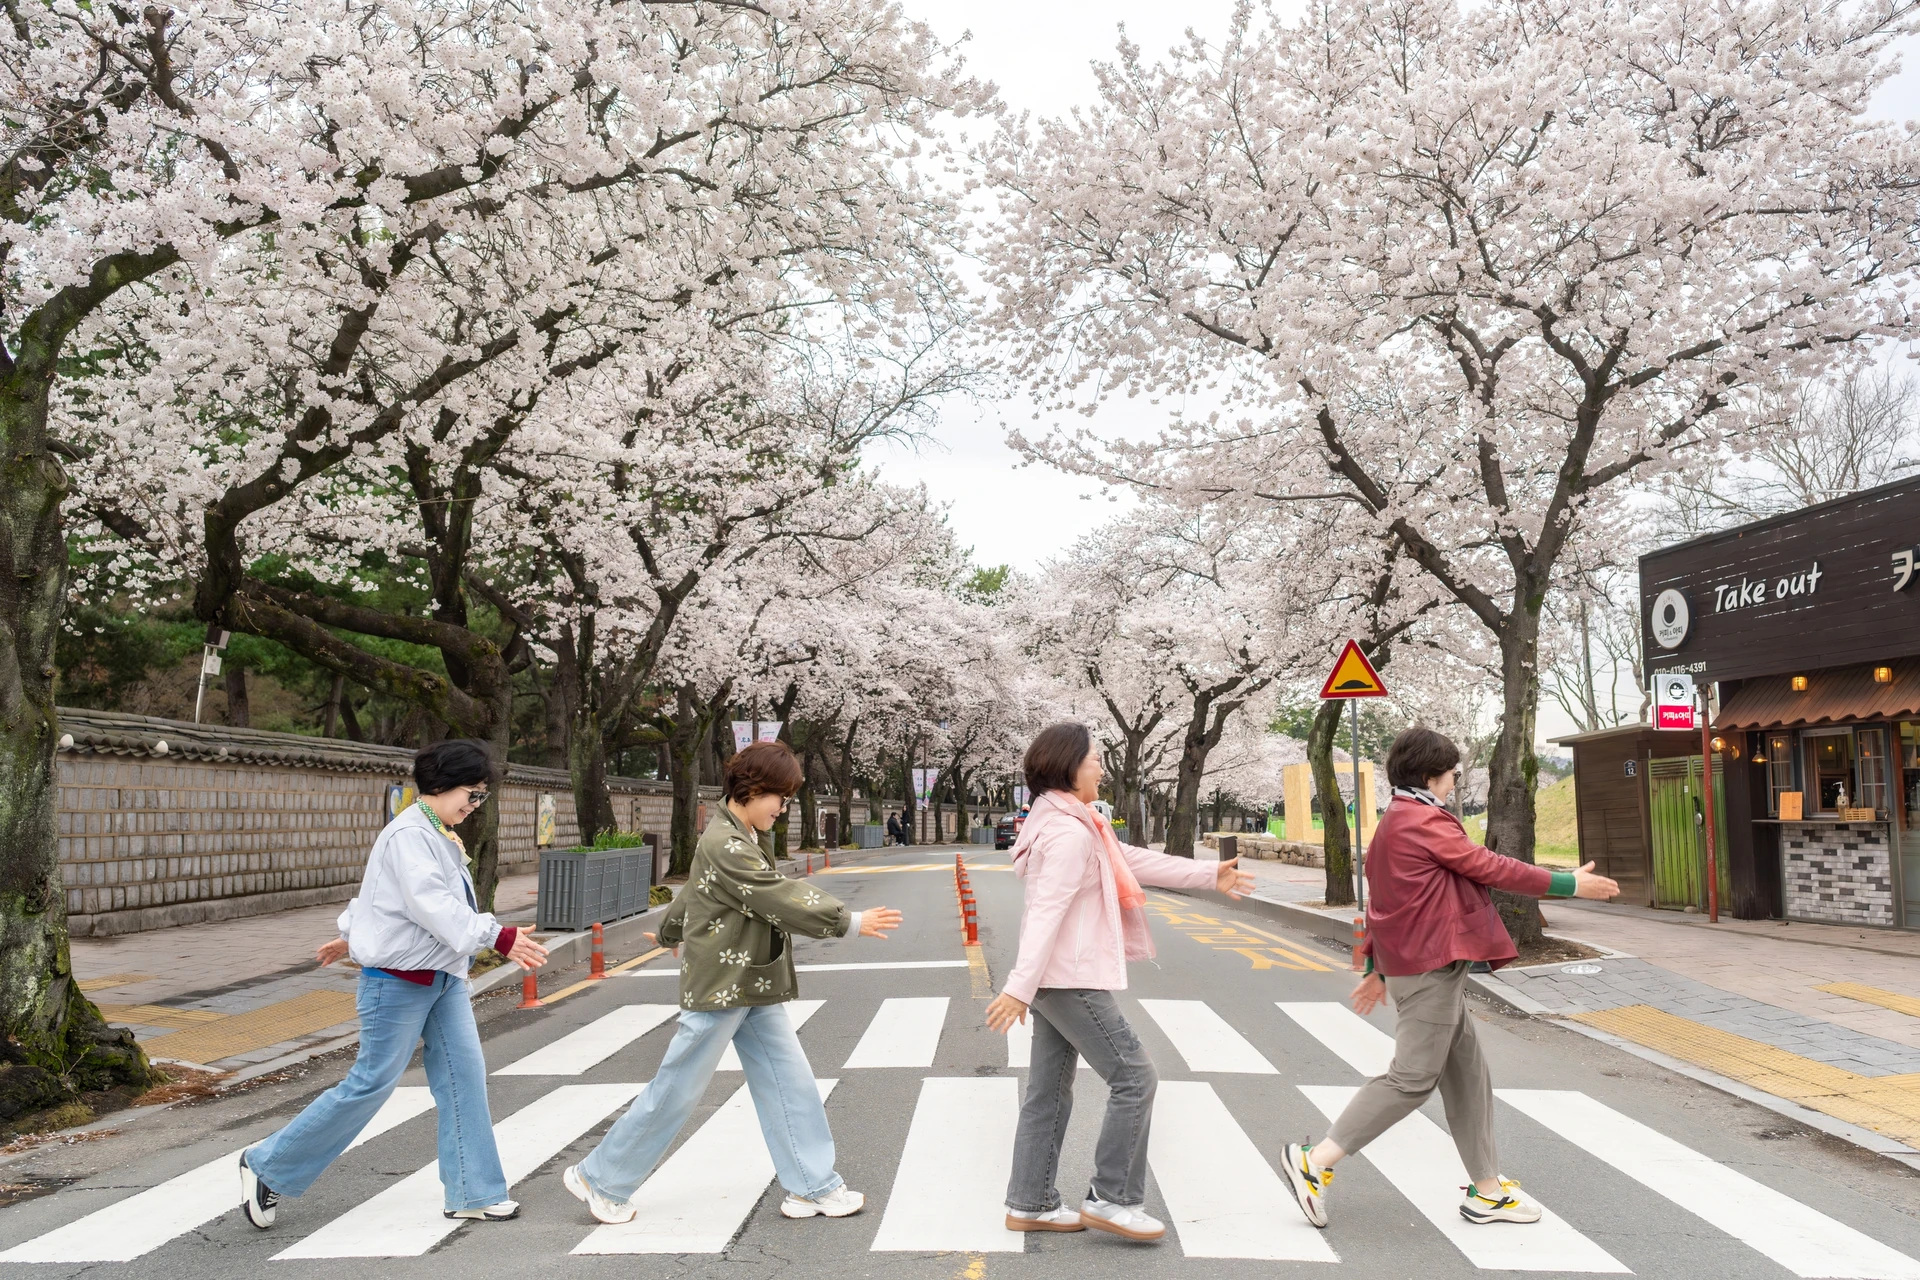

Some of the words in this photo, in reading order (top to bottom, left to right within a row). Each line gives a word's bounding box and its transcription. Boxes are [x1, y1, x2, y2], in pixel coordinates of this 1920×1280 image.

[1715, 577, 1766, 612] Take
[1776, 562, 1822, 599] out
[1627, 767, 1635, 775] 12
